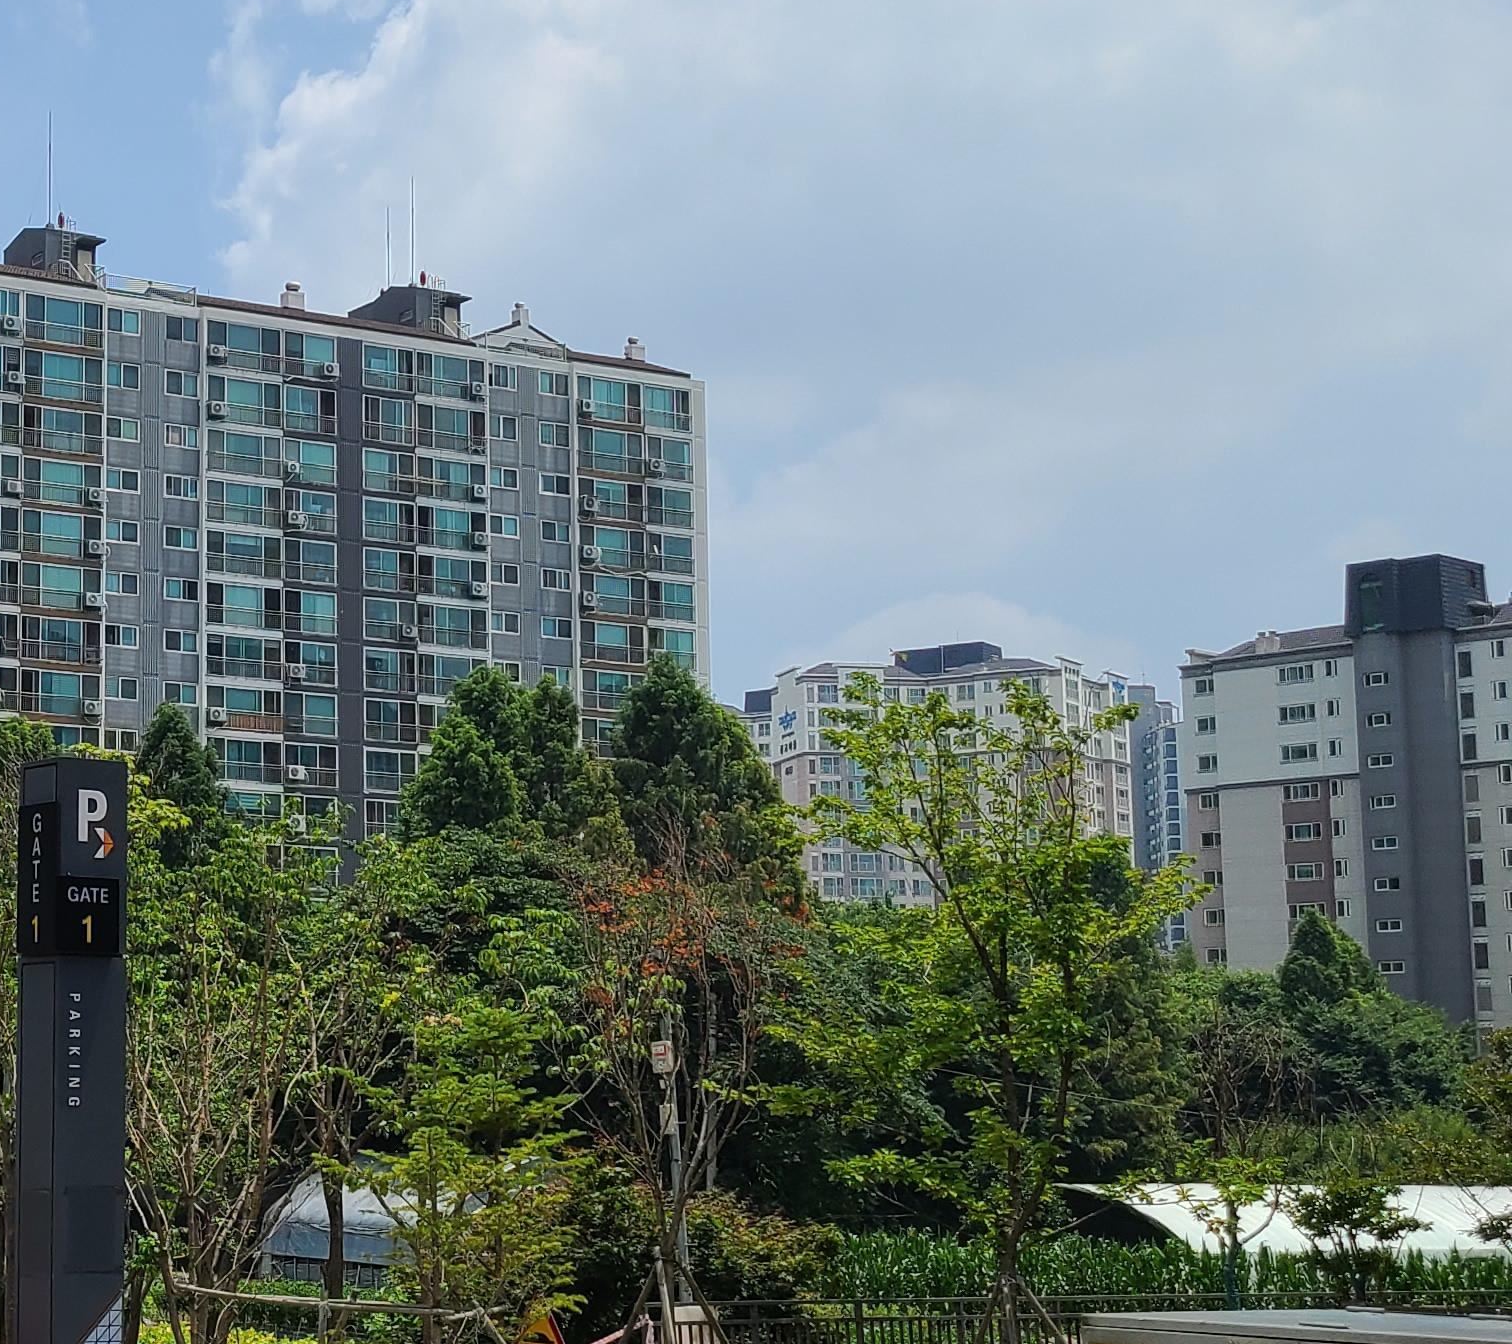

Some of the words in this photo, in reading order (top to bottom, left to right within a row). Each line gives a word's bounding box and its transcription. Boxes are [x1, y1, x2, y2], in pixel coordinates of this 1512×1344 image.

[32, 812, 42, 903] GATE
[67, 885, 110, 904] GATE
[31, 914, 39, 943] 1
[81, 914, 92, 944] 1
[68, 992, 81, 1107] PARKING
